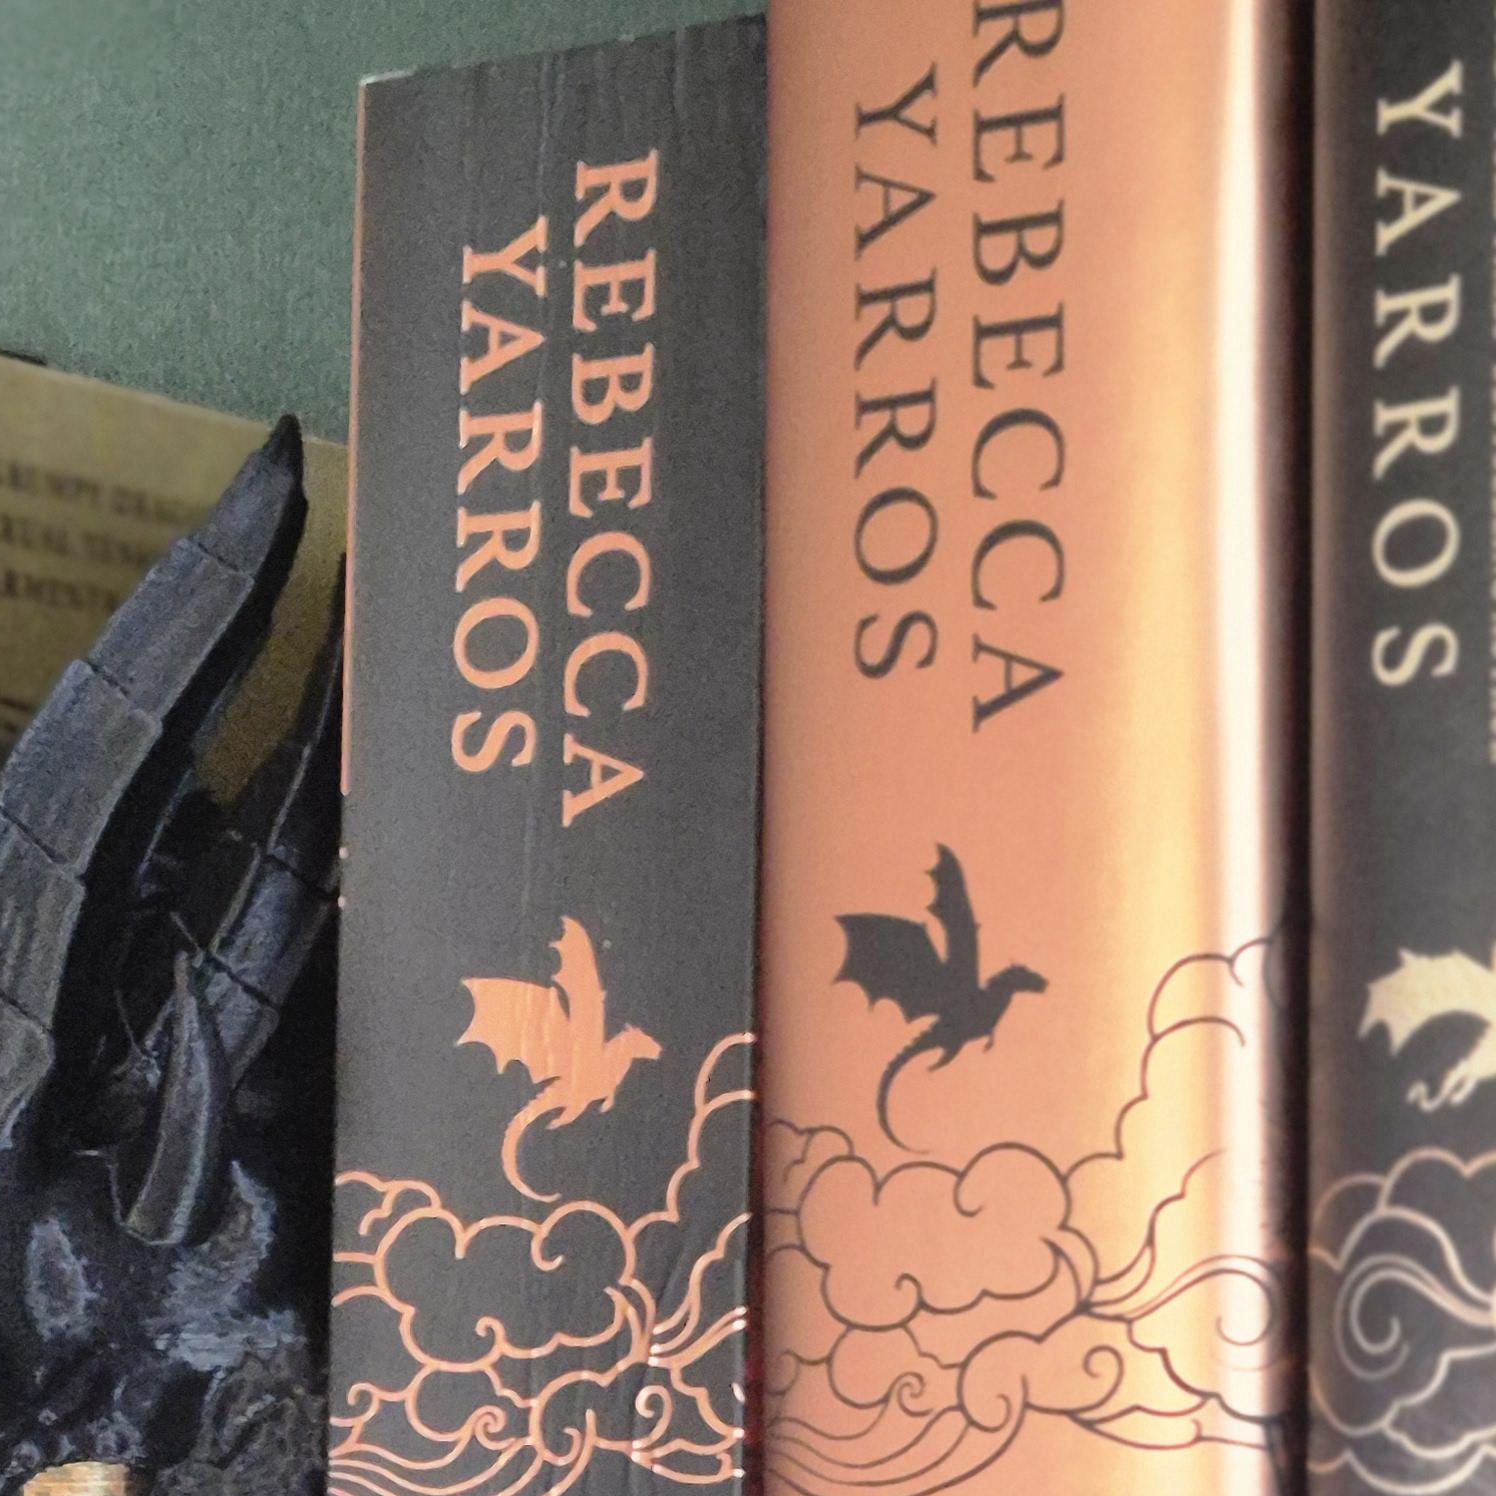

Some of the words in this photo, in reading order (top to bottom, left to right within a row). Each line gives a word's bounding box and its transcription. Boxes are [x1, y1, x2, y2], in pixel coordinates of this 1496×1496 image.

[450, 215, 549, 774] YARROS
[562, 147, 660, 829] REBECCA
[853, 59, 940, 680] YARROS
[970, 0, 1066, 735] REBECCA
[1371, 59, 1464, 688] YARROS
